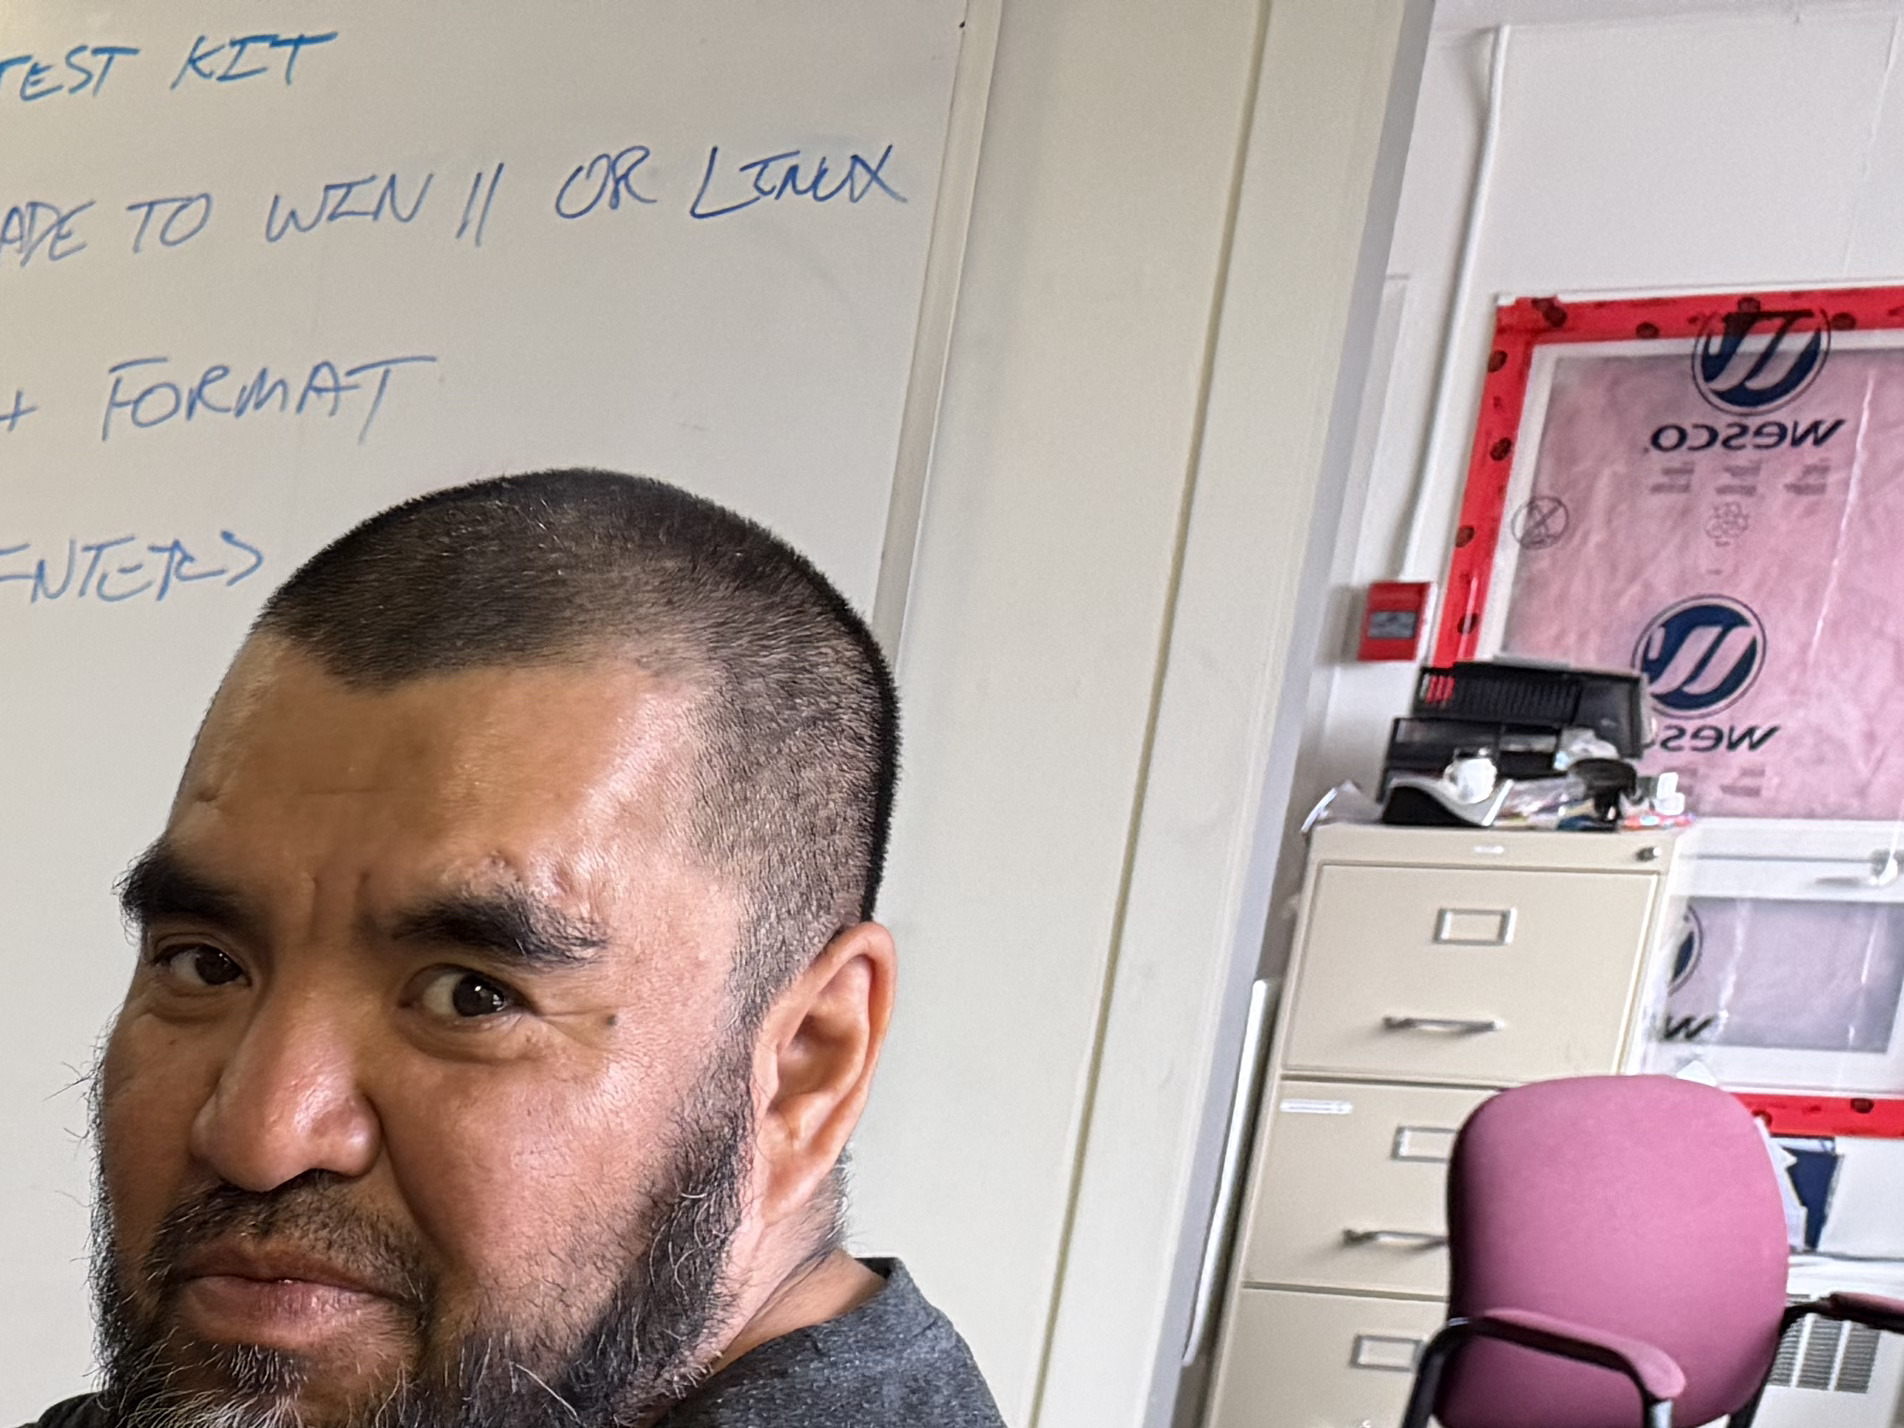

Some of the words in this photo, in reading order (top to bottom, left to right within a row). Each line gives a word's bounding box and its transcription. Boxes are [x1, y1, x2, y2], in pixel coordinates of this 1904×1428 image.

[170, 31, 338, 91] KIT
[126, 192, 214, 254] TO
[266, 172, 434, 243] WIN
[554, 145, 658, 220] OR
[690, 144, 908, 220] LINUX
[100, 354, 438, 445] FORMAT
